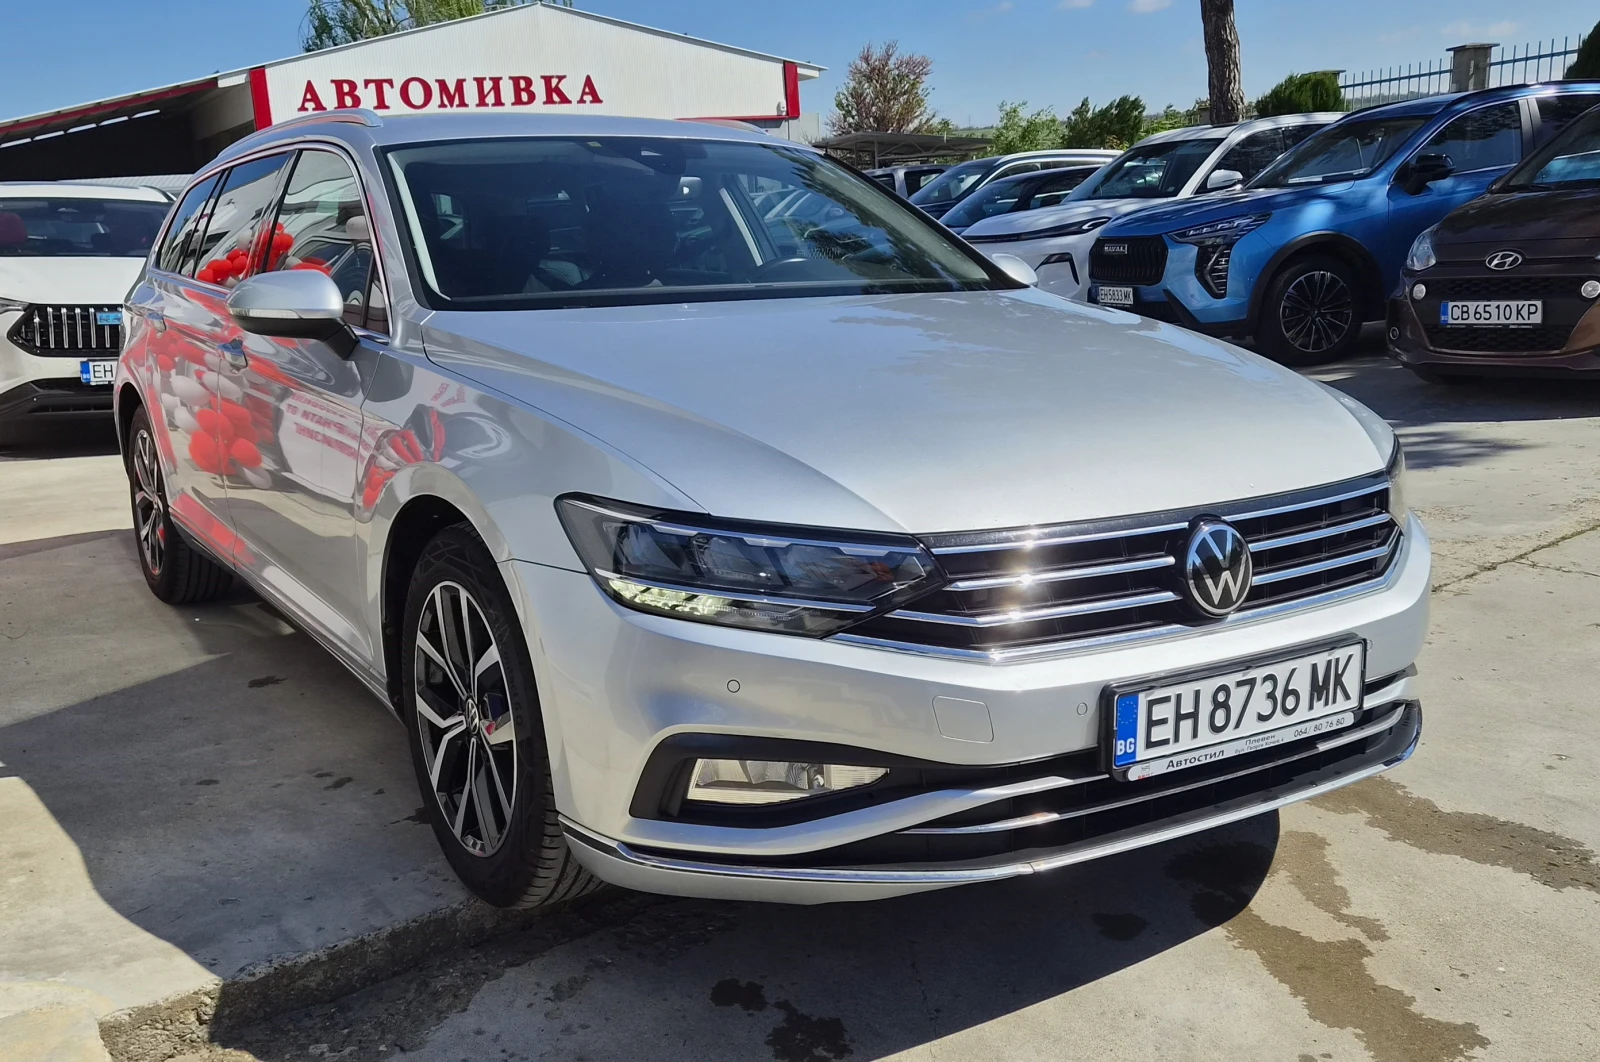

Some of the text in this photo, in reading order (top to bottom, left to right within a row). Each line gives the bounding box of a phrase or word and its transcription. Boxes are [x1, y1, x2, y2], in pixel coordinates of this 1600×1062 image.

[297, 74, 604, 112] АВТОМИВКА
[1450, 303, 1539, 321] CB 6510 KP
[93, 364, 114, 379] EH
[1145, 653, 1354, 750] EH 8736 MK
[1313, 722, 1323, 733] 80
[1325, 720, 1334, 730] 76
[1335, 717, 1345, 726] 80
[1116, 737, 1135, 756] BG
[1245, 734, 1276, 746] Плевен
[1166, 749, 1225, 770] Автостил
